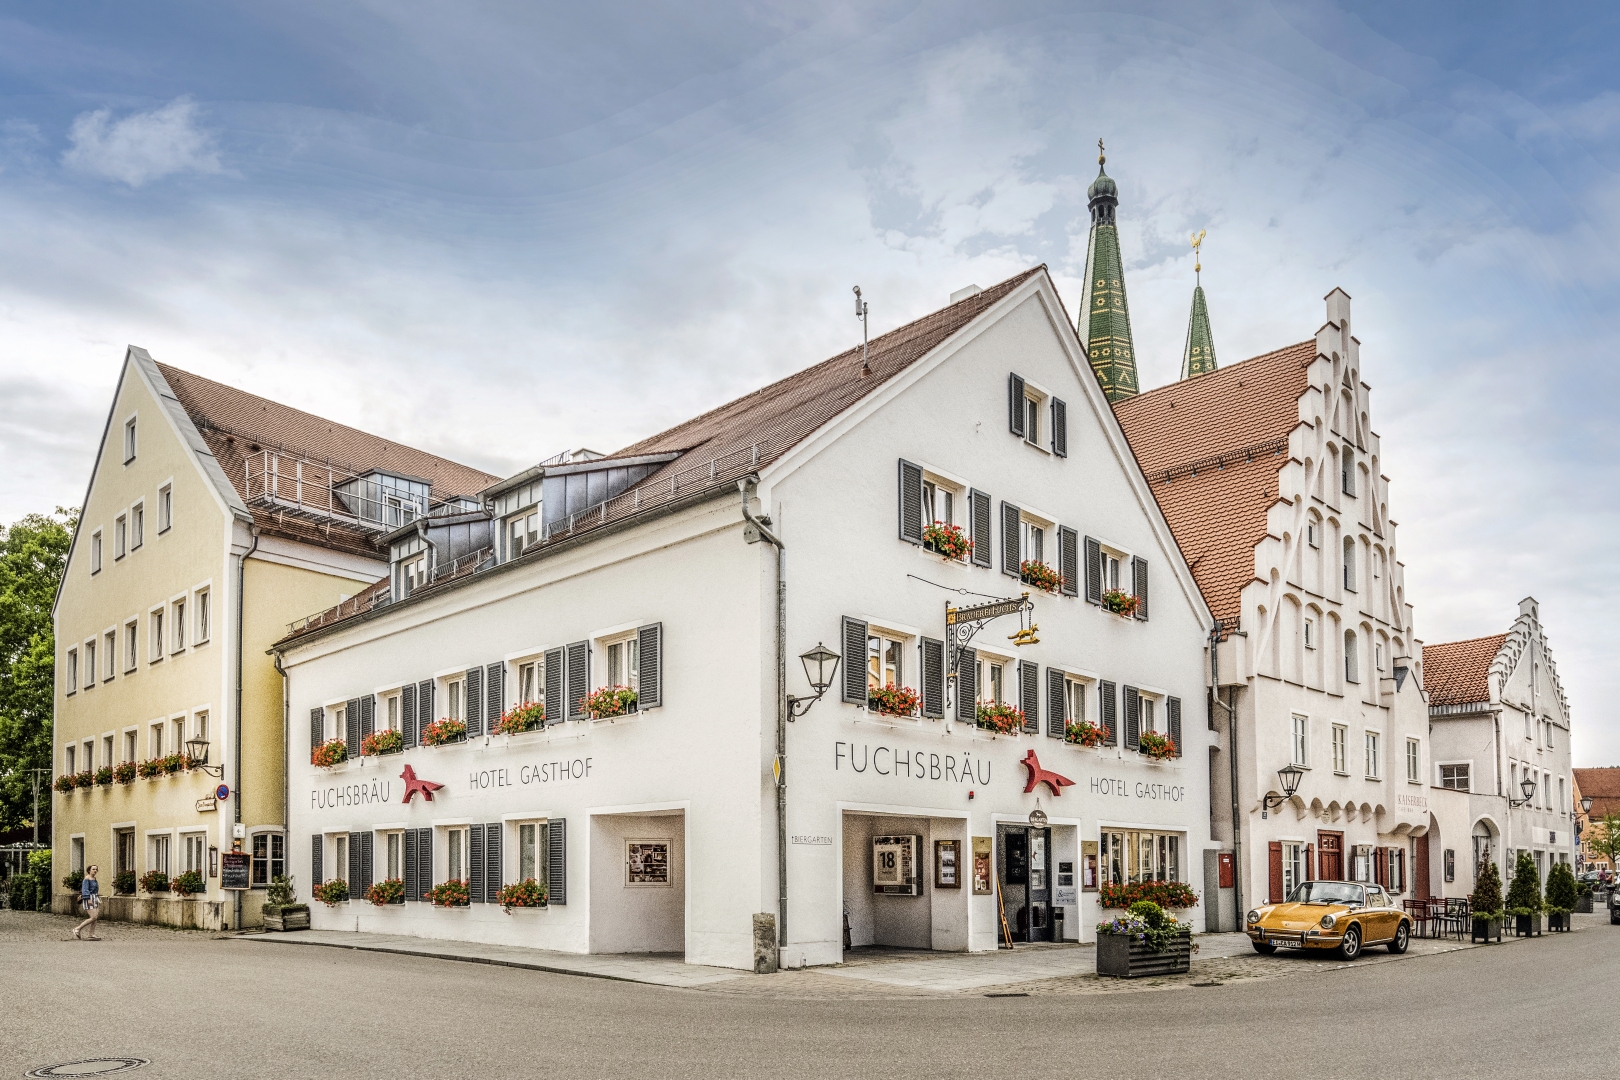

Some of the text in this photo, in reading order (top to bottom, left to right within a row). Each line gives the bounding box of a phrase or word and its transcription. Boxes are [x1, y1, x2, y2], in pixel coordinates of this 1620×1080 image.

[956, 603, 1017, 622] BRAUEREI FUCHS
[469, 757, 593, 790] HOTEL GASTHOF
[835, 741, 991, 786] FUCHSBRÄU
[311, 778, 391, 810] FUCHSBRÄU
[1090, 776, 1185, 802] HOTEL GASTHOF
[1398, 794, 1428, 808] KAISERBECK
[794, 835, 833, 844] BIERGARTEN
[879, 851, 896, 869] 18
